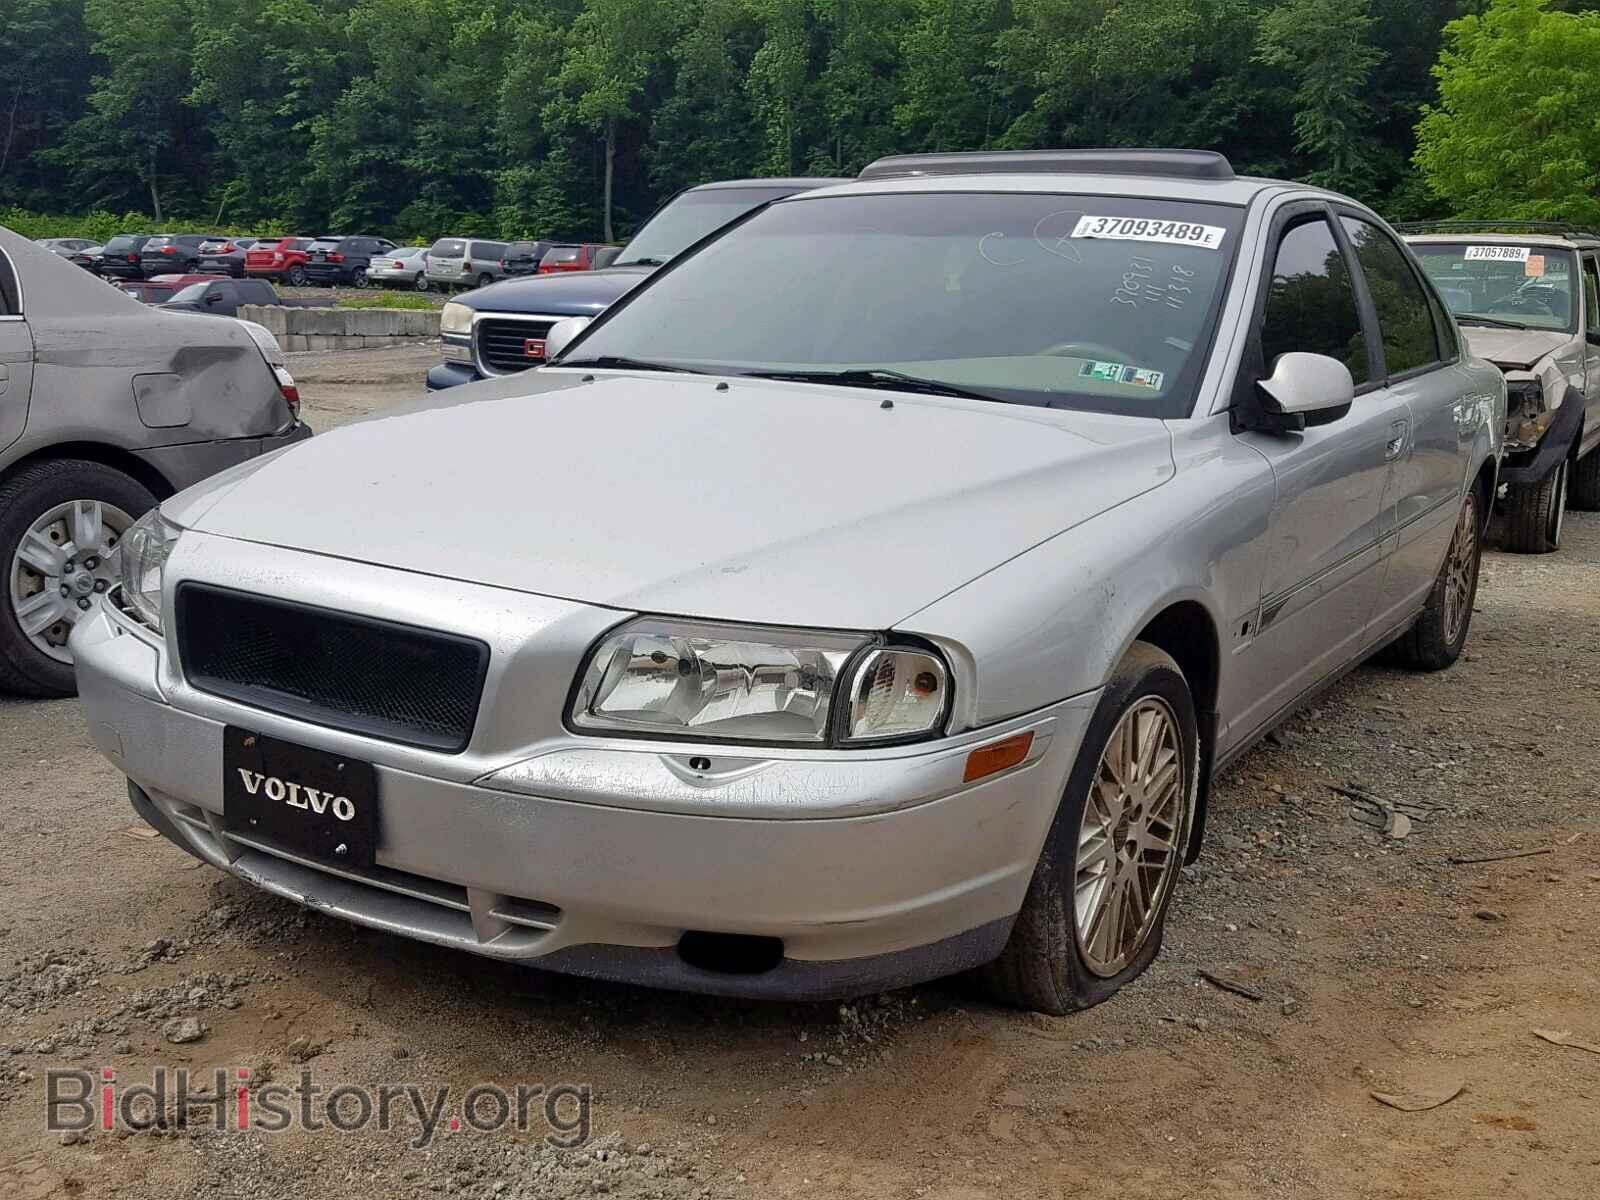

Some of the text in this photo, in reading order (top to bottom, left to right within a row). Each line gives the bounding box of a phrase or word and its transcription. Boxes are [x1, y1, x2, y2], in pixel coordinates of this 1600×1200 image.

[1092, 217, 1205, 241] 37093489
[1472, 247, 1521, 259] 37057889
[237, 768, 355, 821] VOLVO
